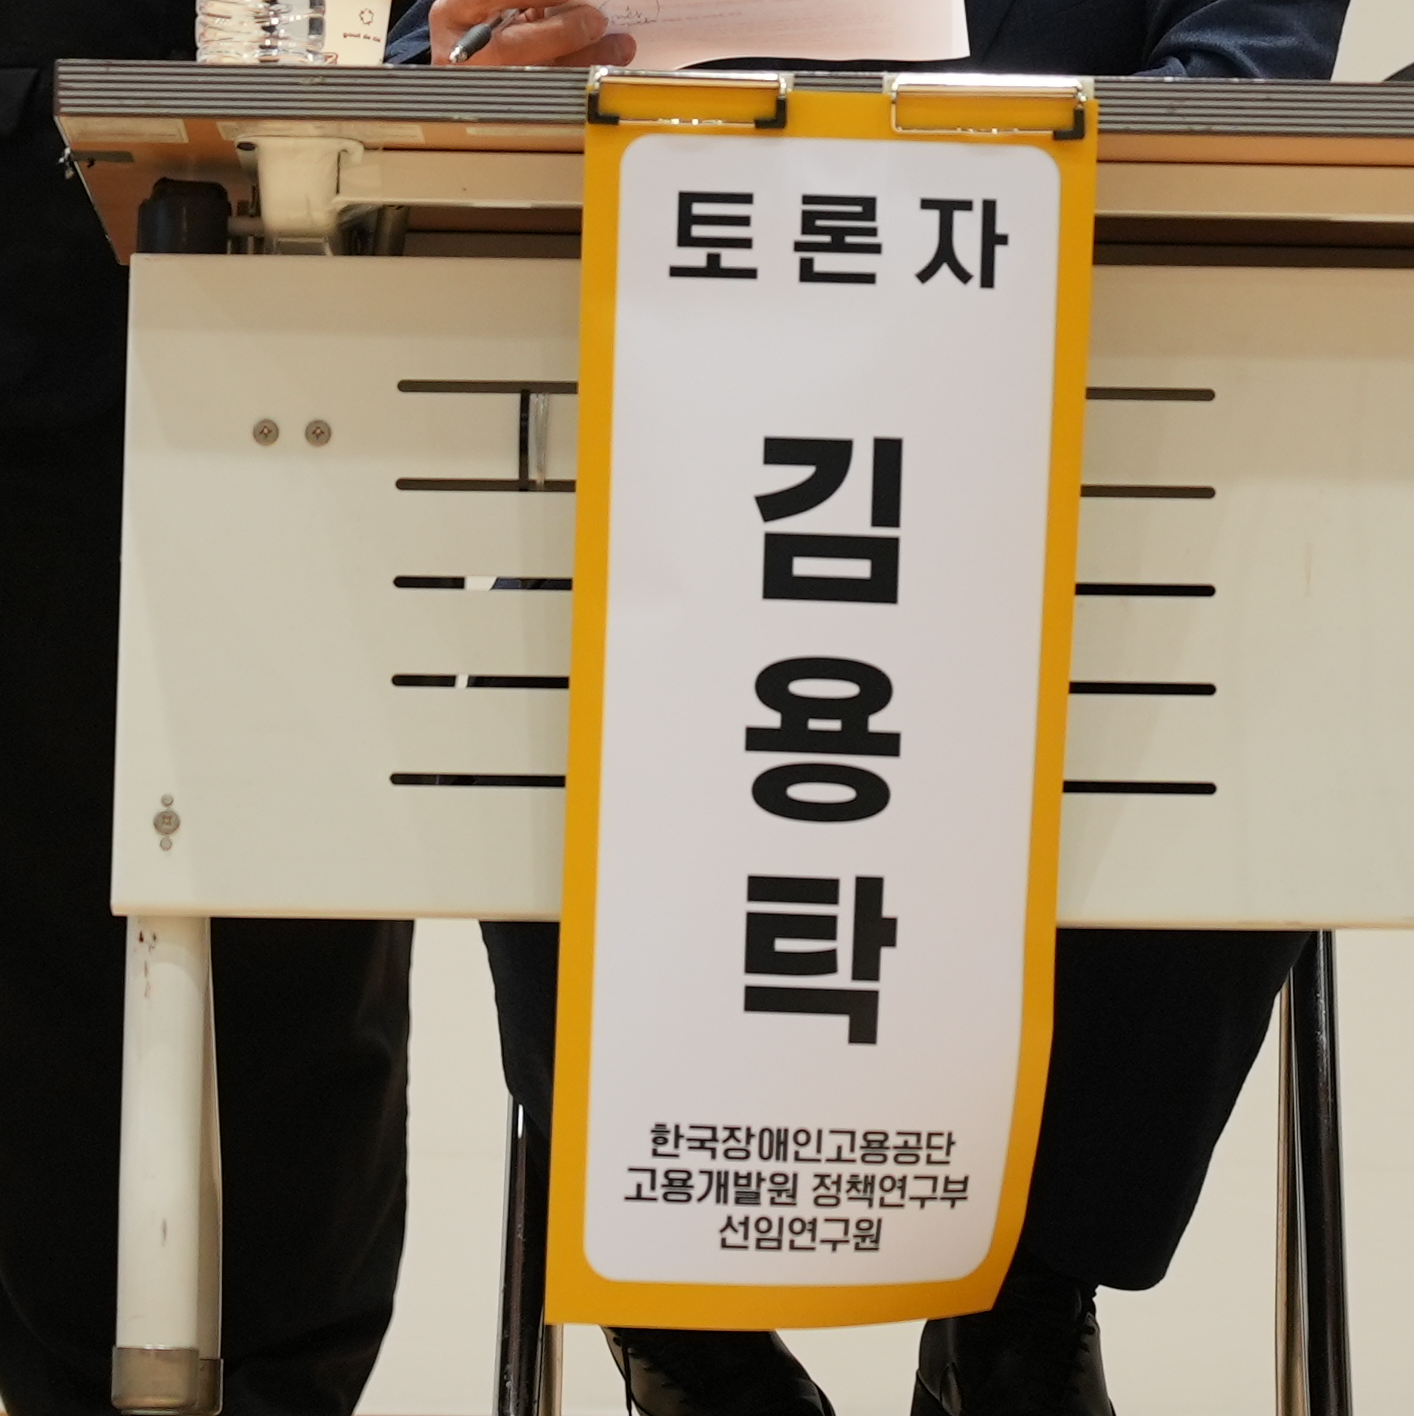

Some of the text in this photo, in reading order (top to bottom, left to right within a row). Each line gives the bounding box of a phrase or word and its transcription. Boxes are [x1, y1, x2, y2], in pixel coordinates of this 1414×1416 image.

[668, 191, 1009, 289] 토론자
[743, 436, 903, 1045] 김용탁
[649, 1122, 956, 1166] 한국장애인고용공단
[623, 1165, 970, 1209] 고용개발원 정책연구부
[718, 1214, 884, 1253] 선임연구원
